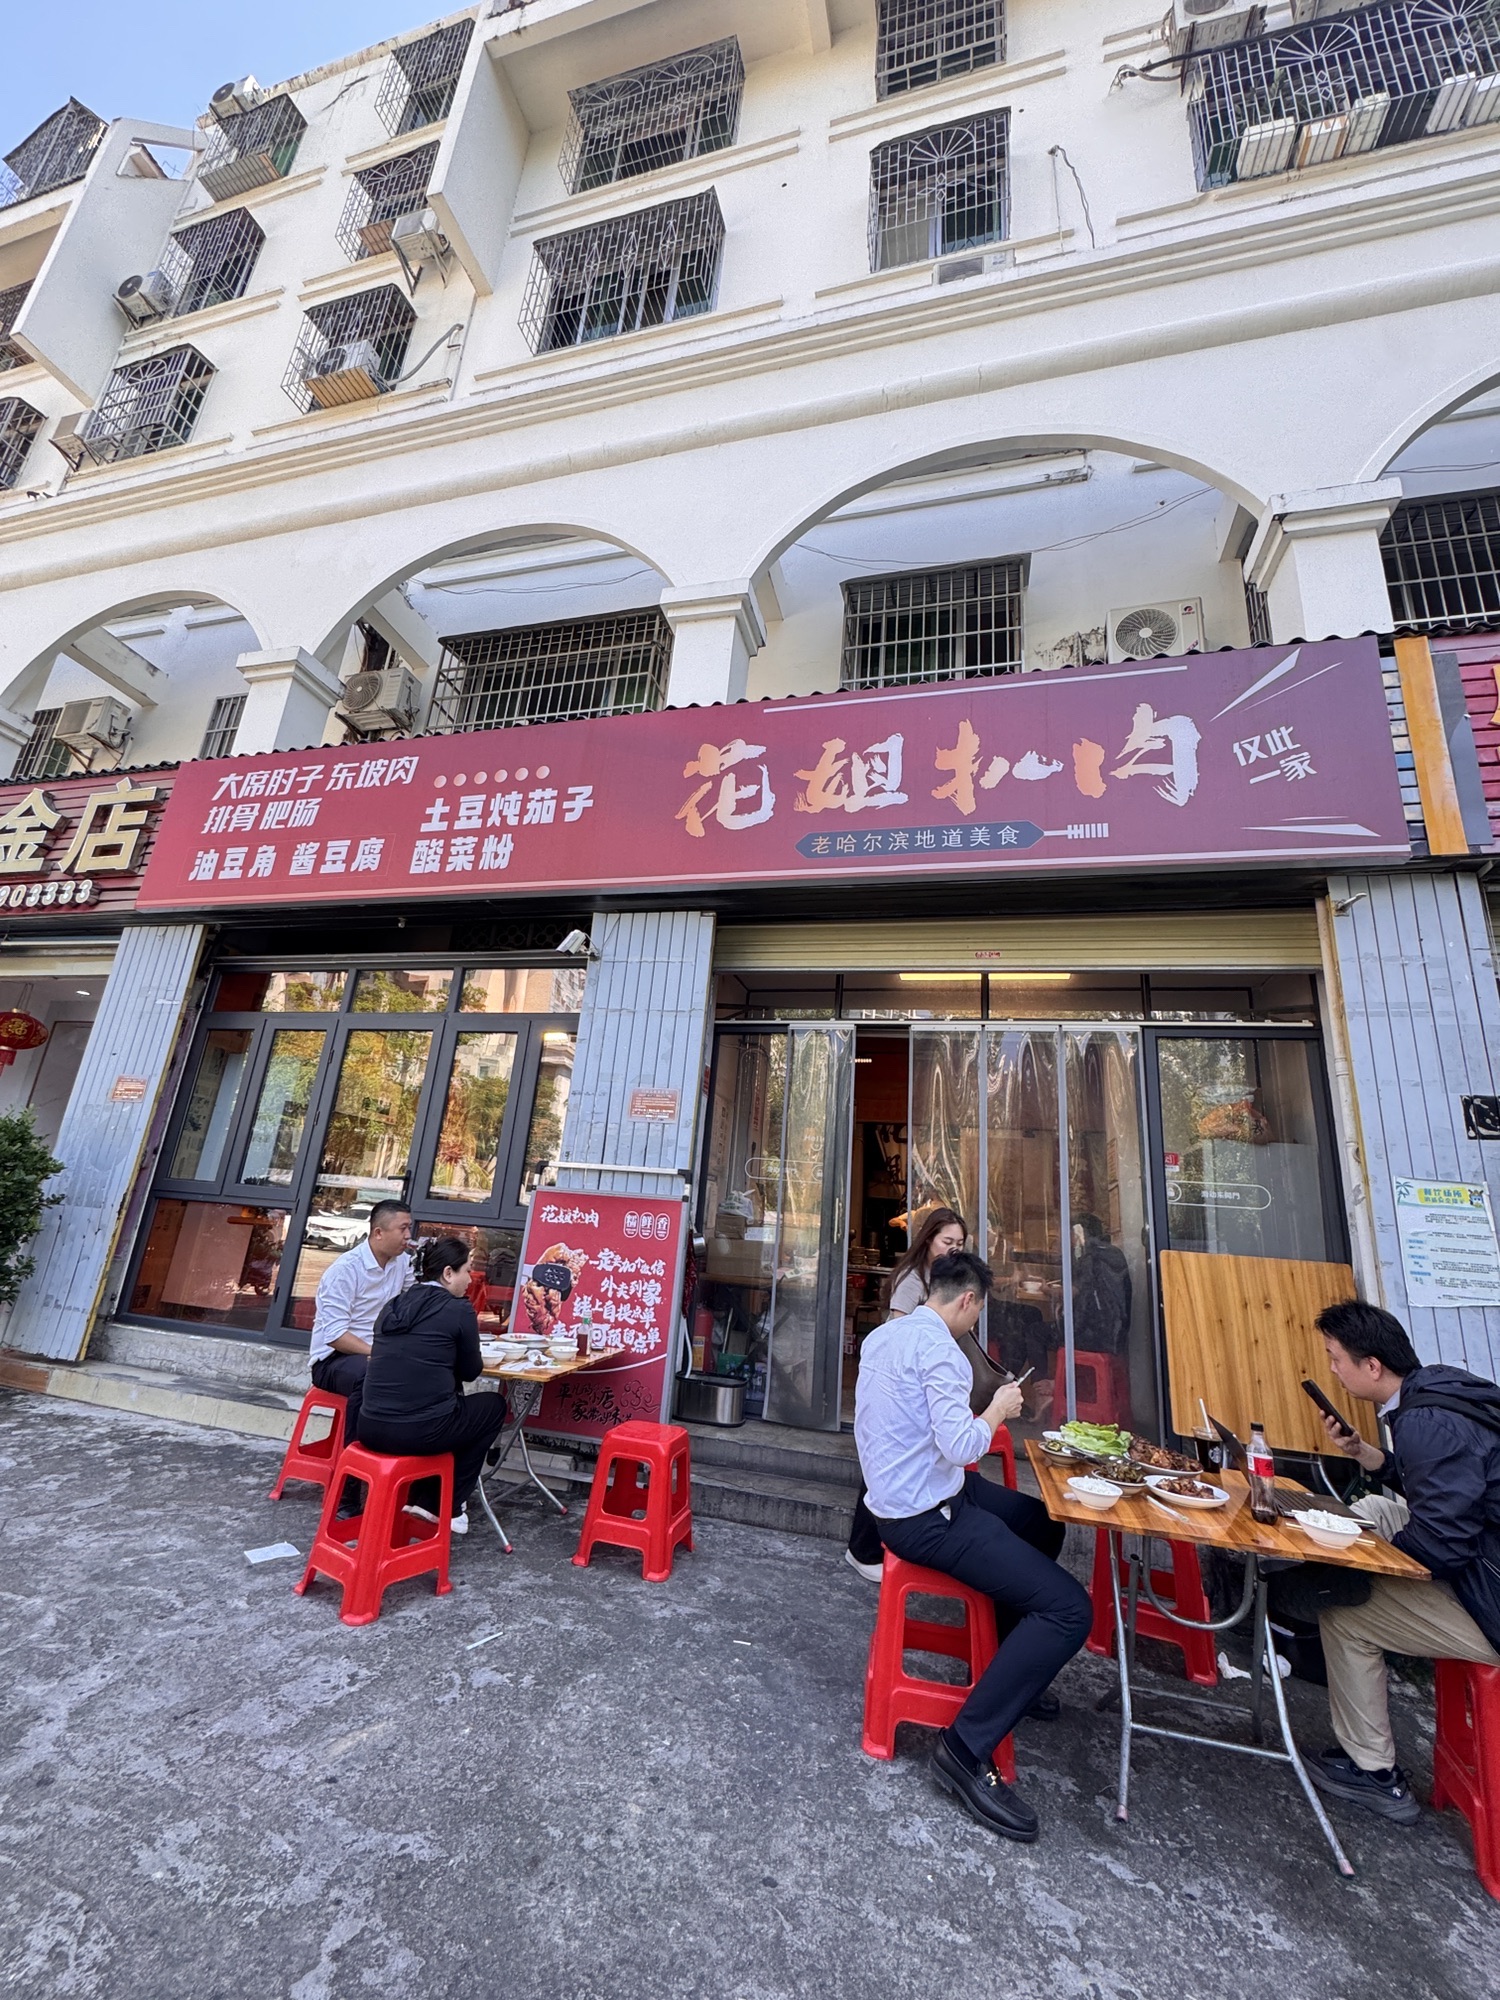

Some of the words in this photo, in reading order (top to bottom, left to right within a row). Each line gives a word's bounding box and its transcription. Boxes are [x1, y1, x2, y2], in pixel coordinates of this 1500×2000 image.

[1233, 726, 1301, 767] 仅此
[211, 764, 325, 801] 大席肘子
[325, 756, 419, 792] 东坡肉
[675, 703, 1202, 838] 花姐扒肉
[1250, 751, 1318, 785] 一家
[201, 803, 261, 834] 排骨
[259, 797, 322, 831] 肥肠
[420, 785, 594, 833] 土豆炖茄子
[188, 844, 277, 881] 油豆角
[289, 837, 385, 876] 酱豆腐
[409, 833, 514, 874] 酸菜粉
[811, 825, 1020, 854] 老哈尔滨地道美食
[601, 1275, 661, 1306] 外卖到家
